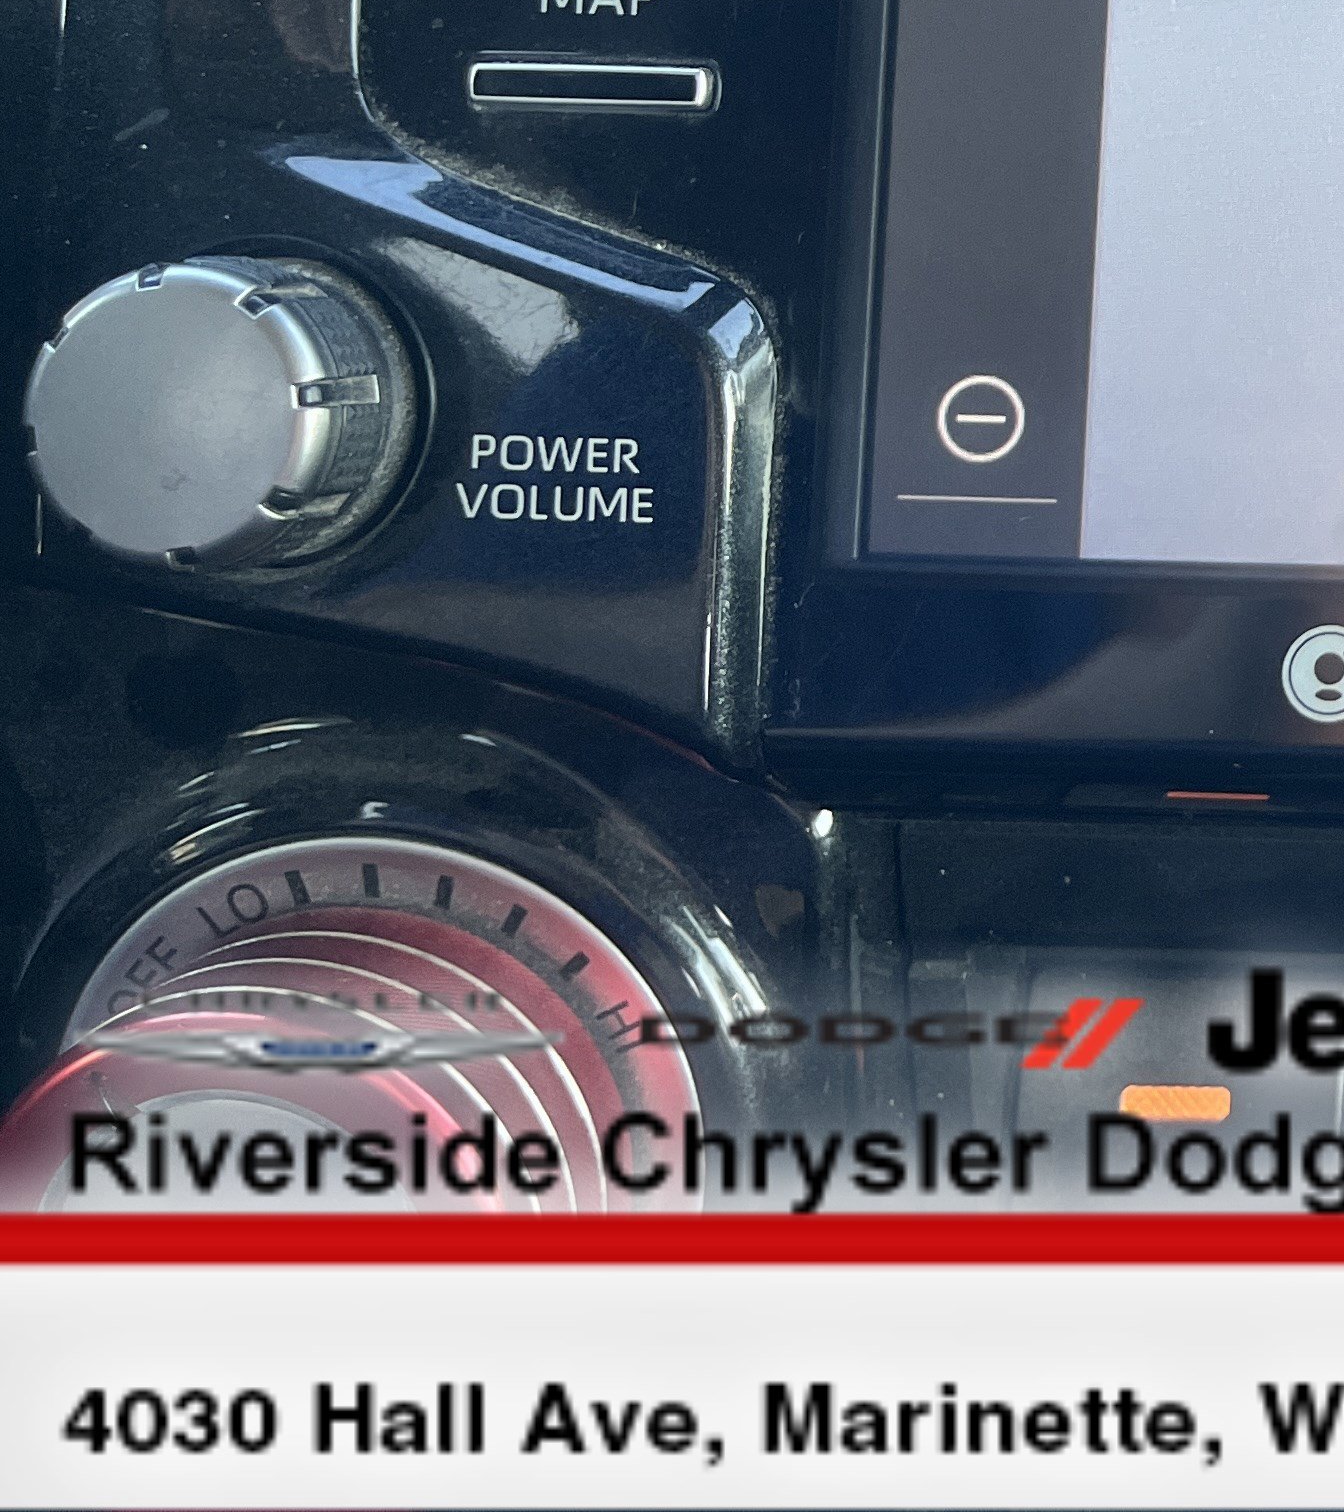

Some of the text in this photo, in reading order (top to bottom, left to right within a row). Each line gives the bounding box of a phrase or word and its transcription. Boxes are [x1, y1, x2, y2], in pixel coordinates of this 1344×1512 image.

[469, 433, 641, 474] POWER
[456, 482, 654, 524] VOLUME
[196, 883, 270, 938] LO
